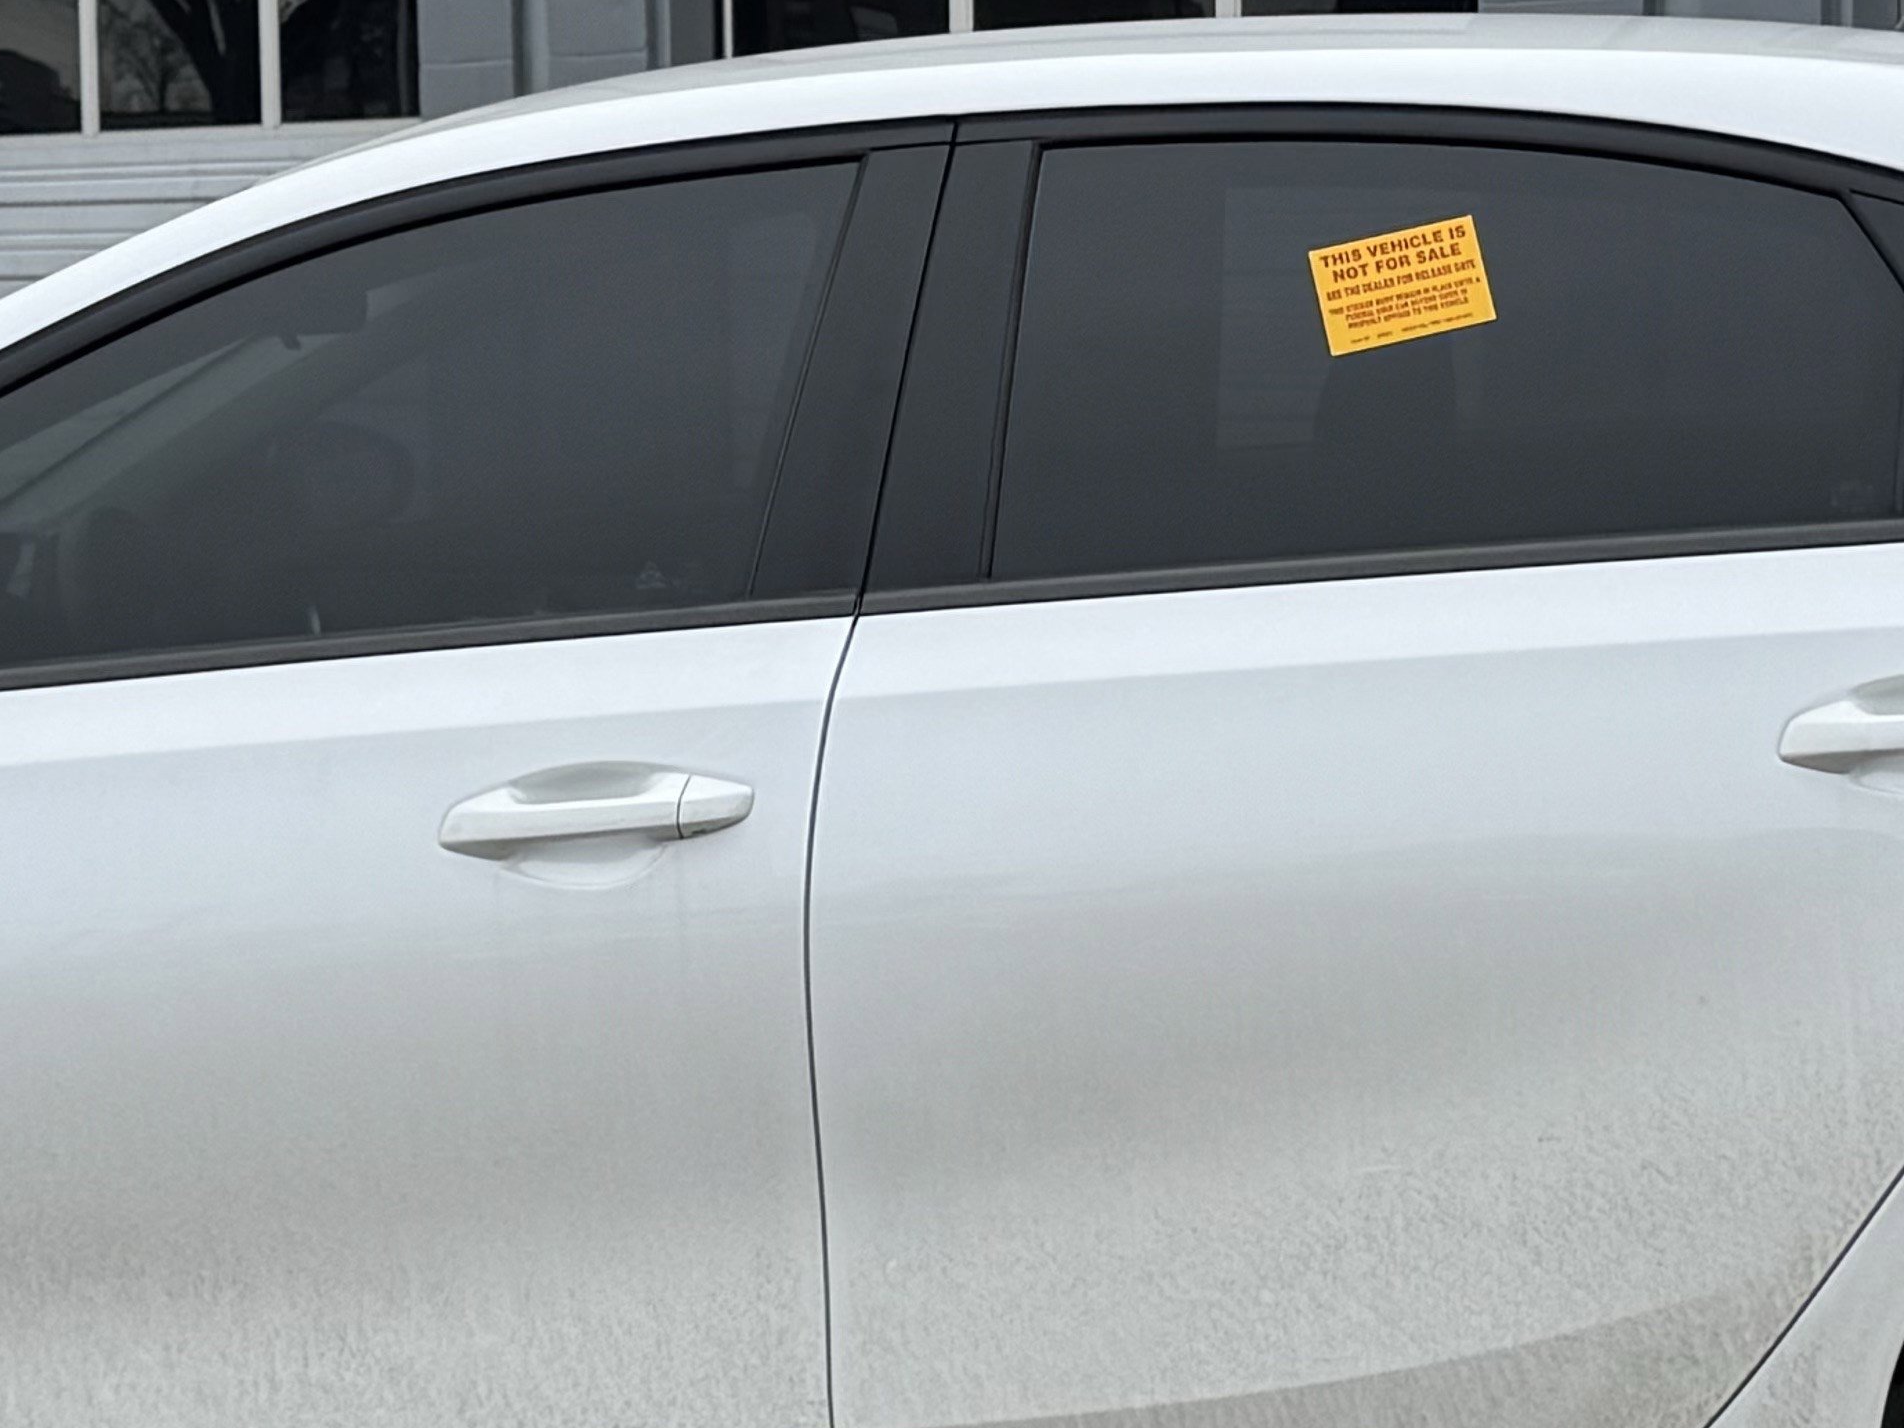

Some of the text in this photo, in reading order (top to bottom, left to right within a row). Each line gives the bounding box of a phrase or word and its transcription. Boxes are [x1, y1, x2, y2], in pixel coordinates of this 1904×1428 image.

[1319, 225, 1466, 268] THIS VEHICLE IS
[1332, 242, 1462, 283] NOT FOR SALE
